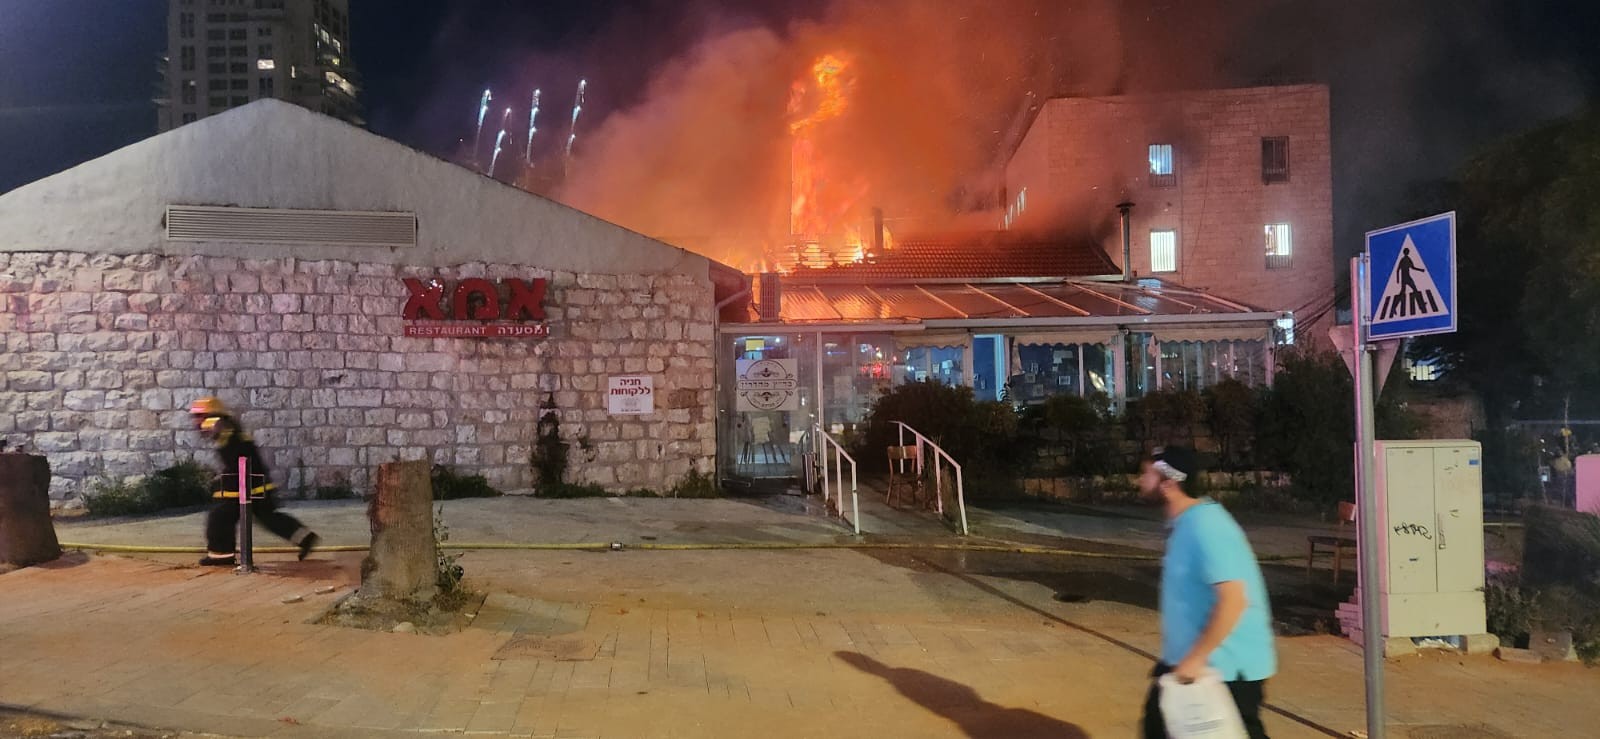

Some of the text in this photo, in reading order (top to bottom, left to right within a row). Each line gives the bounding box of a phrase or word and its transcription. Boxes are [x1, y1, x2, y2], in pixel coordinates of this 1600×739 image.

[401, 277, 547, 320] אמא
[409, 326, 487, 336] RESTAURANT
[620, 378, 641, 386] חניה
[610, 386, 651, 396] ללקוחות
